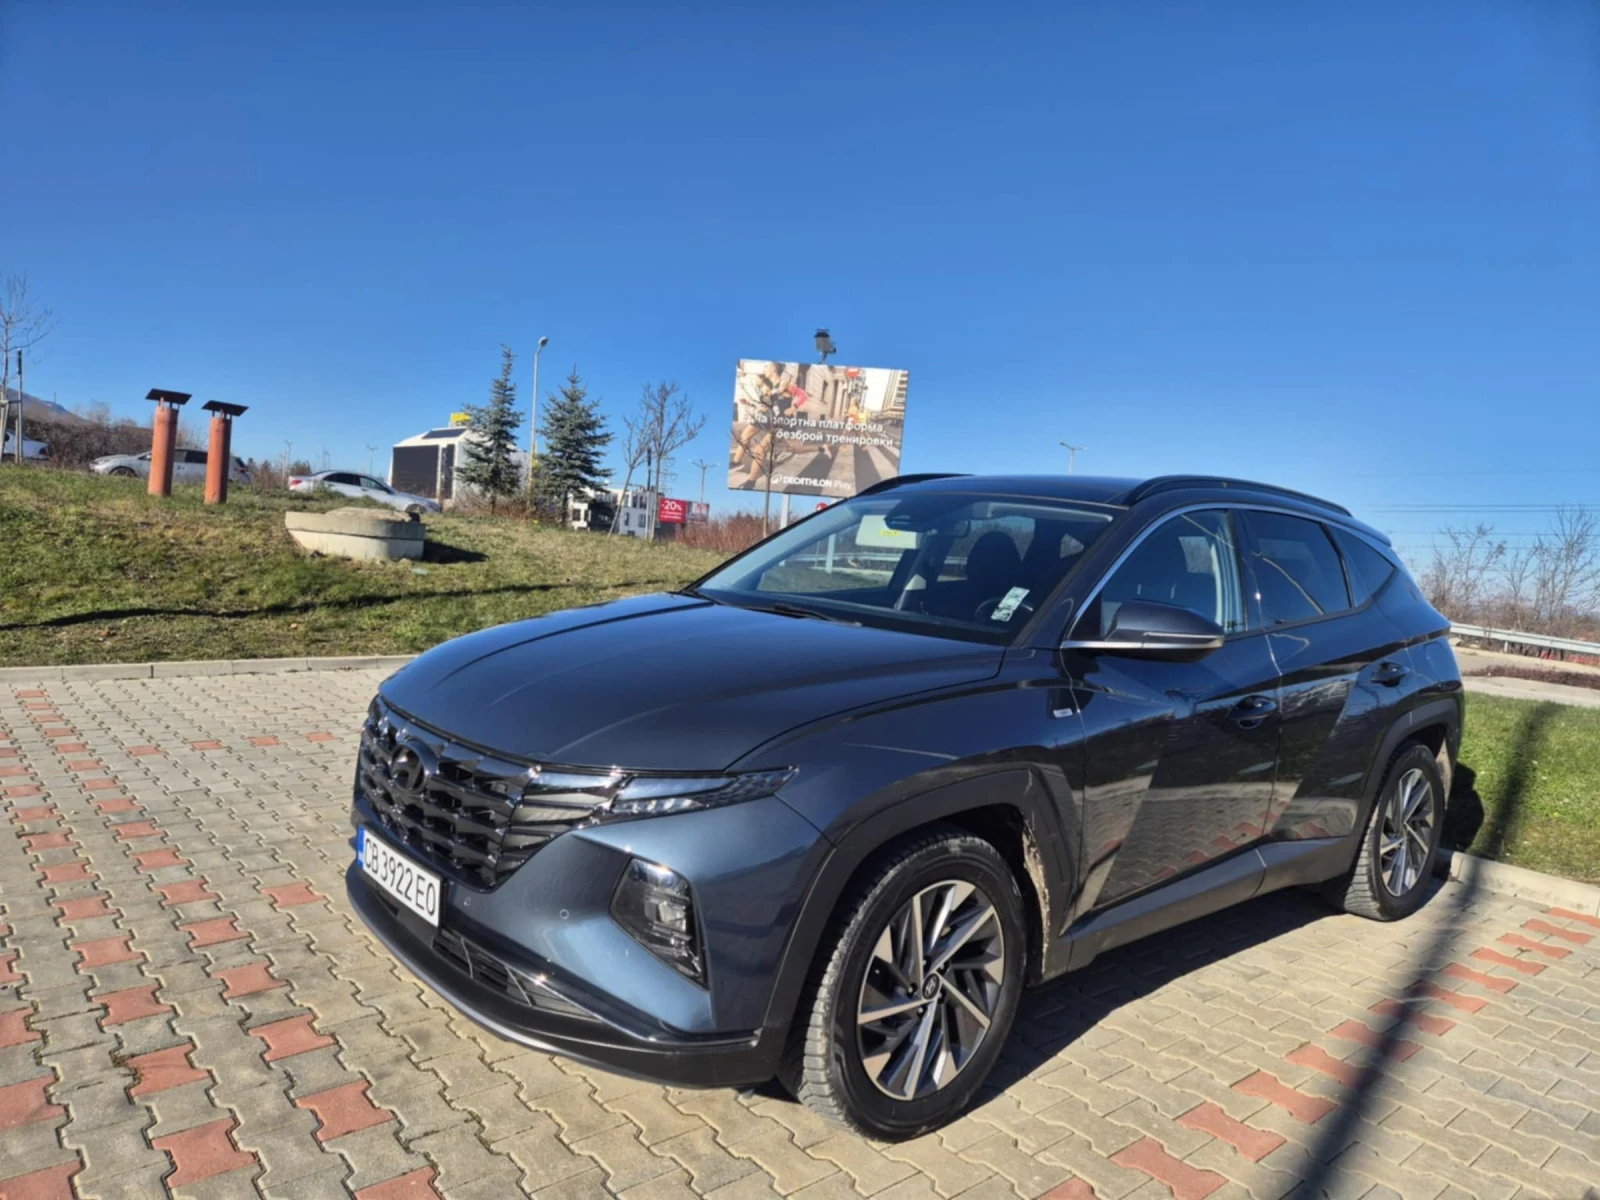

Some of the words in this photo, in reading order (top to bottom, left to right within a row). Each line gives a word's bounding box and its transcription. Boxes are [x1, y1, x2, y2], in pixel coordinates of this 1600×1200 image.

[819, 418, 886, 433] платформа,
[776, 429, 823, 442] безброй
[826, 433, 894, 447] тренировки
